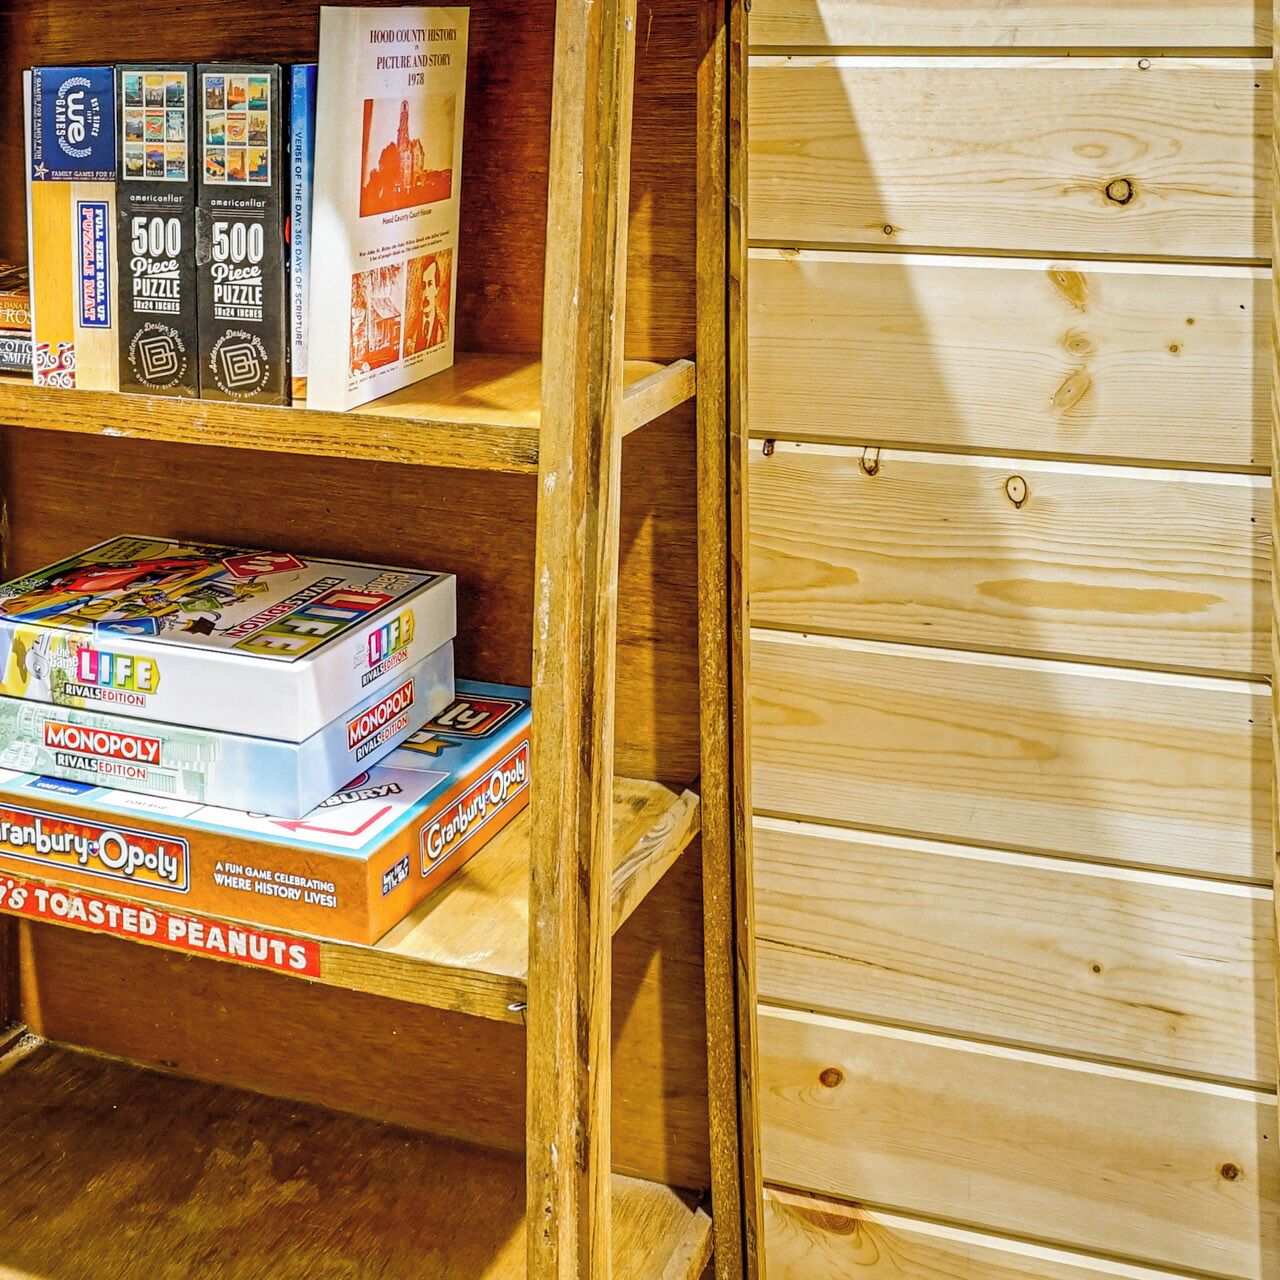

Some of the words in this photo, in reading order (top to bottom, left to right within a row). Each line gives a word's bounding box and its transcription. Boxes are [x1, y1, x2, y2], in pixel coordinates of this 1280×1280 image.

[369, 29, 395, 44] HOOD
[395, 29, 427, 43] COUNTY
[427, 28, 458, 41] HISTORY
[376, 55, 412, 70] PICTURE
[412, 55, 428, 68] AND
[429, 53, 451, 67] STORY
[407, 72, 425, 87] 1978
[55, 99, 66, 137] GAMES
[66, 90, 86, 144] we
[90, 115, 101, 137] SINCE
[294, 131, 303, 164] VERSE
[295, 166, 303, 180] OF
[129, 193, 182, 203] americanflat
[210, 198, 265, 208] americanflat
[295, 181, 303, 203] THE
[95, 209, 104, 239] FULL
[295, 204, 303, 226] DAY:
[81, 207, 95, 277] PUZZLE
[131, 216, 182, 258] 500
[212, 221, 264, 264] 500
[295, 228, 303, 246] 365
[95, 241, 105, 270] SIZE
[129, 256, 179, 278] Piece
[295, 248, 303, 274] DAYS
[210, 262, 262, 284] Piece
[295, 275, 303, 290] OF
[84, 280, 96, 321] MAT
[96, 273, 105, 303] ROLL
[132, 278, 181, 299] PUZZLE
[213, 284, 263, 305] PUZZLE
[3, 302, 23, 310] DANA
[6, 310, 32, 324] ROS
[97, 306, 106, 322] UP
[155, 300, 181, 312] INCHES
[236, 307, 263, 319] INCHES
[295, 292, 303, 347] SCRIPTURE
[127, 328, 144, 366] Anderson
[144, 321, 169, 333] Design
[169, 327, 186, 353] Group
[209, 335, 226, 374] Anderson
[225, 329, 252, 341] Design
[252, 335, 268, 361] Group
[1, 353, 34, 365] SMITH
[136, 373, 160, 390] QUALITY
[162, 378, 179, 390] SINCE
[217, 381, 242, 399] QUALITY
[243, 387, 262, 399] SINCE
[294, 578, 341, 607] RIVALS
[225, 603, 294, 638] EDITION
[242, 592, 383, 651] LIFE
[369, 612, 412, 665] LIFE
[48, 656, 79, 668] Game
[56, 647, 71, 657] the
[79, 650, 154, 690] LIFE
[362, 664, 384, 686] RIVALS
[383, 650, 408, 672] EDITION
[65, 684, 101, 700] RIVALS
[102, 691, 144, 706] EDITION
[349, 683, 413, 747] MONOPOLY
[46, 726, 160, 762] MONOPOLY
[357, 736, 382, 761] RIVALS
[381, 718, 408, 743] EDITION
[57, 753, 97, 771] RIVALS
[98, 760, 146, 779] EDITION
[320, 782, 402, 808] BURY!
[426, 792, 488, 859] Granbury
[489, 758, 525, 804] Opoly
[98, 830, 178, 882] Opoly
[213, 873, 252, 891] WHERE
[255, 883, 301, 901] HISTORY
[304, 892, 338, 908] LIVES!
[215, 862, 223, 871] A
[225, 863, 243, 875] FUN
[245, 867, 272, 881] GAME
[274, 873, 335, 893] CELEBRATING
[37, 892, 157, 936] TOASTED
[168, 916, 307, 970] PEANUTS
